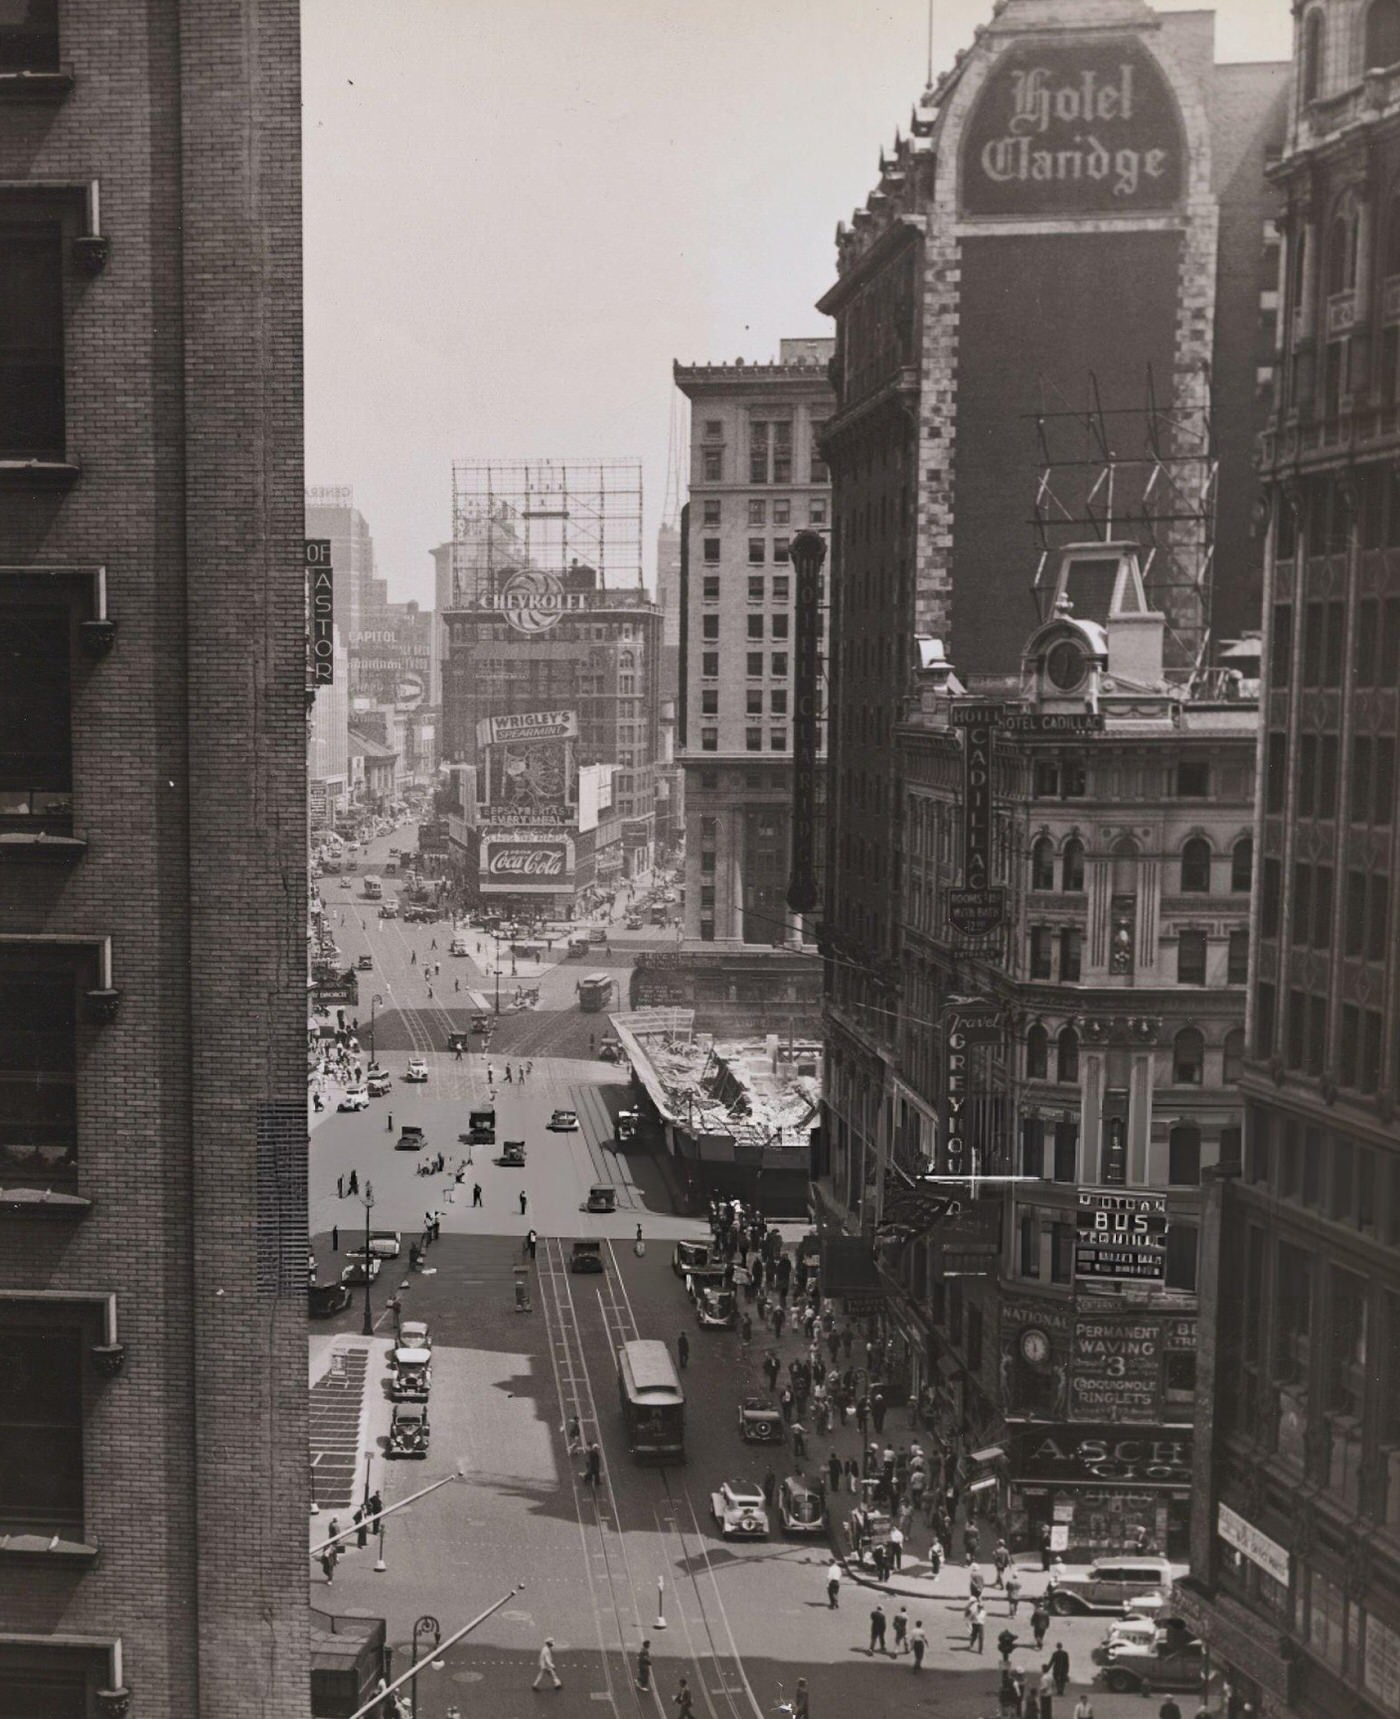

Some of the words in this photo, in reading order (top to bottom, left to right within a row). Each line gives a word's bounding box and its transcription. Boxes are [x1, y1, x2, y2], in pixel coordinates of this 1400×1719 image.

[1009, 64, 1133, 134] Hotel
[981, 135, 1166, 195] Claridge
[307, 544, 330, 562] OF
[479, 592, 586, 609] CHEVROLET
[315, 573, 332, 679] ASTOR
[349, 631, 398, 643] CAPITOL
[495, 711, 570, 729] WRIGLEY'S
[1042, 715, 1100, 729] CADILLAC
[499, 725, 563, 740] SPEARMINT
[969, 728, 987, 889] CADILLAC
[950, 1013, 999, 1034] Travel
[1095, 1211, 1147, 1233] BUS
[1076, 1323, 1160, 1340] PERMANENT
[1079, 1341, 1155, 1356] WAVING
[1079, 1392, 1152, 1405] RINGLETS
